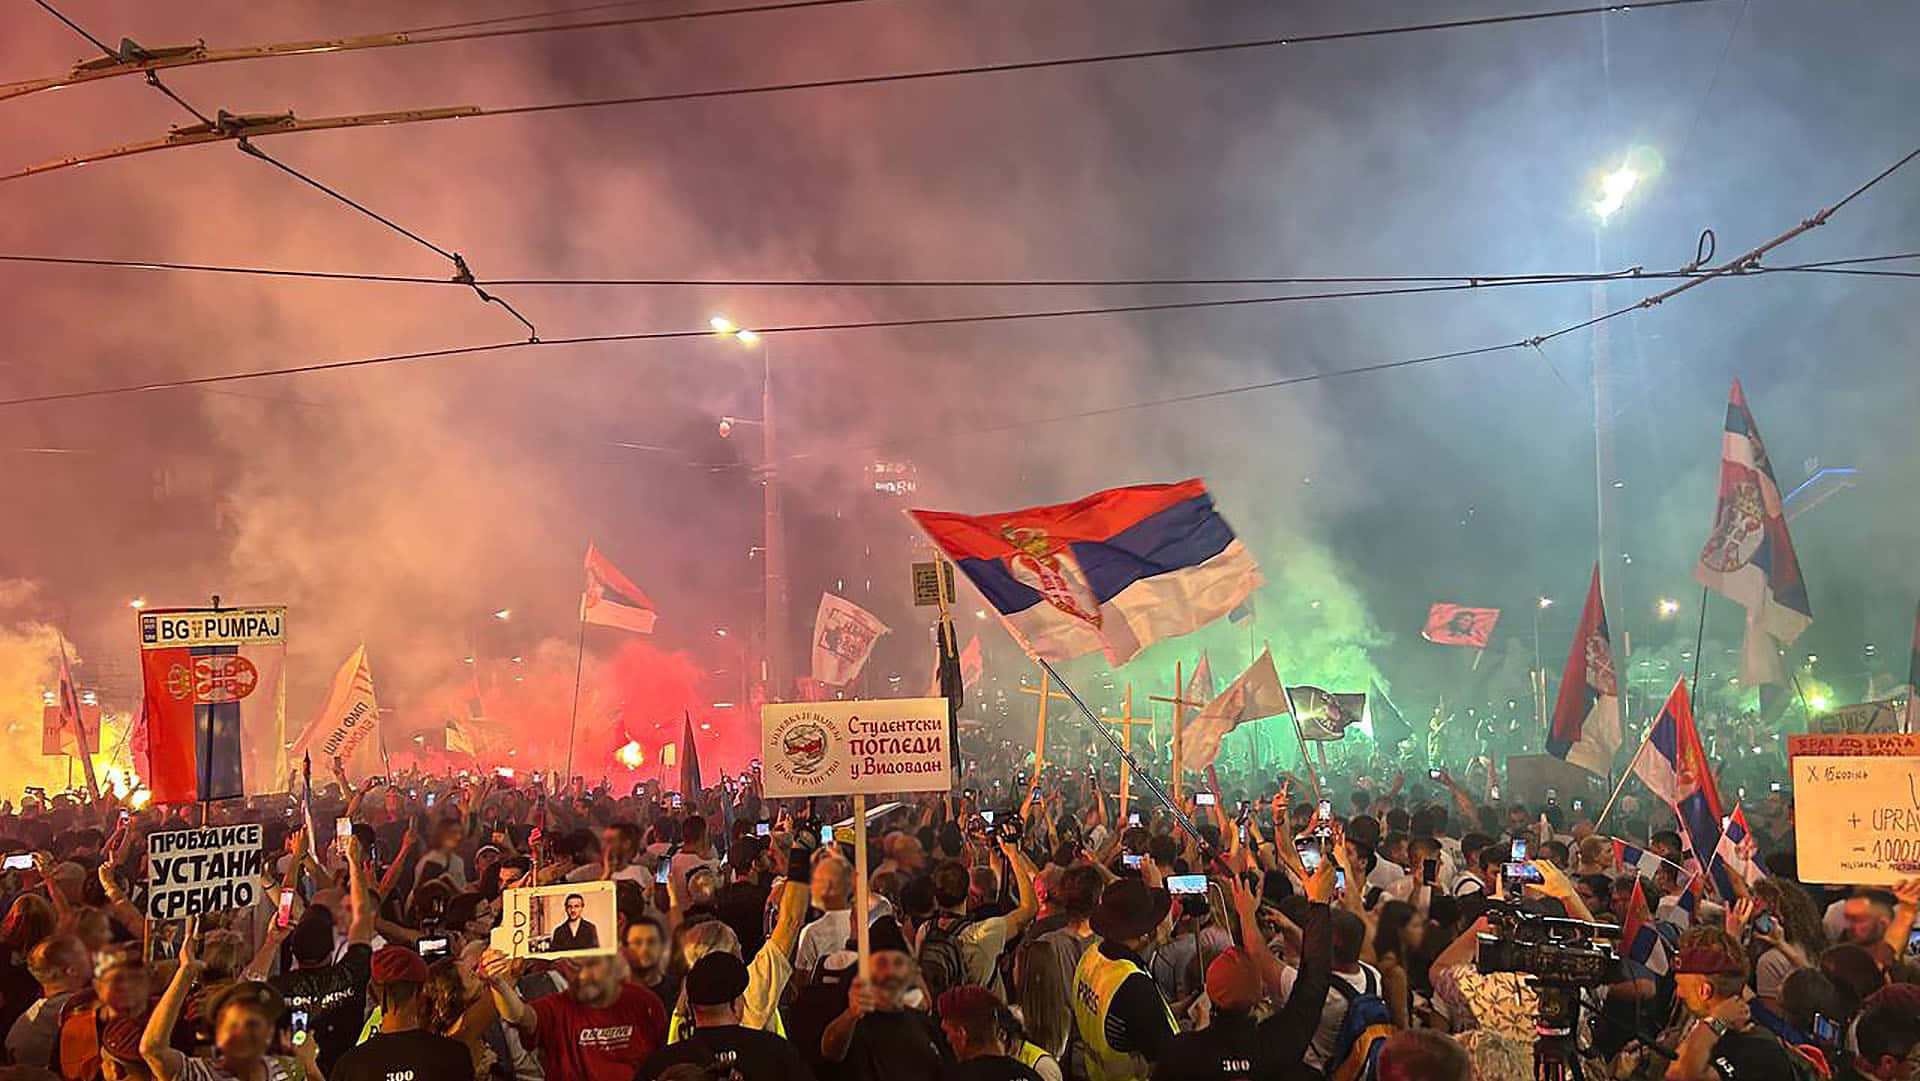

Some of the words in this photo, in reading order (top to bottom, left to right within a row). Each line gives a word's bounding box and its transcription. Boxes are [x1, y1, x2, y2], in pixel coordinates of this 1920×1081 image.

[161, 619, 190, 640] BG
[204, 617, 280, 639] PUMPAJ
[848, 716, 942, 738] Студентски
[850, 763, 859, 780] у
[863, 757, 942, 776] Видовдан
[151, 849, 262, 886] УСТАНИ
[1222, 1060, 1250, 1071] 300
